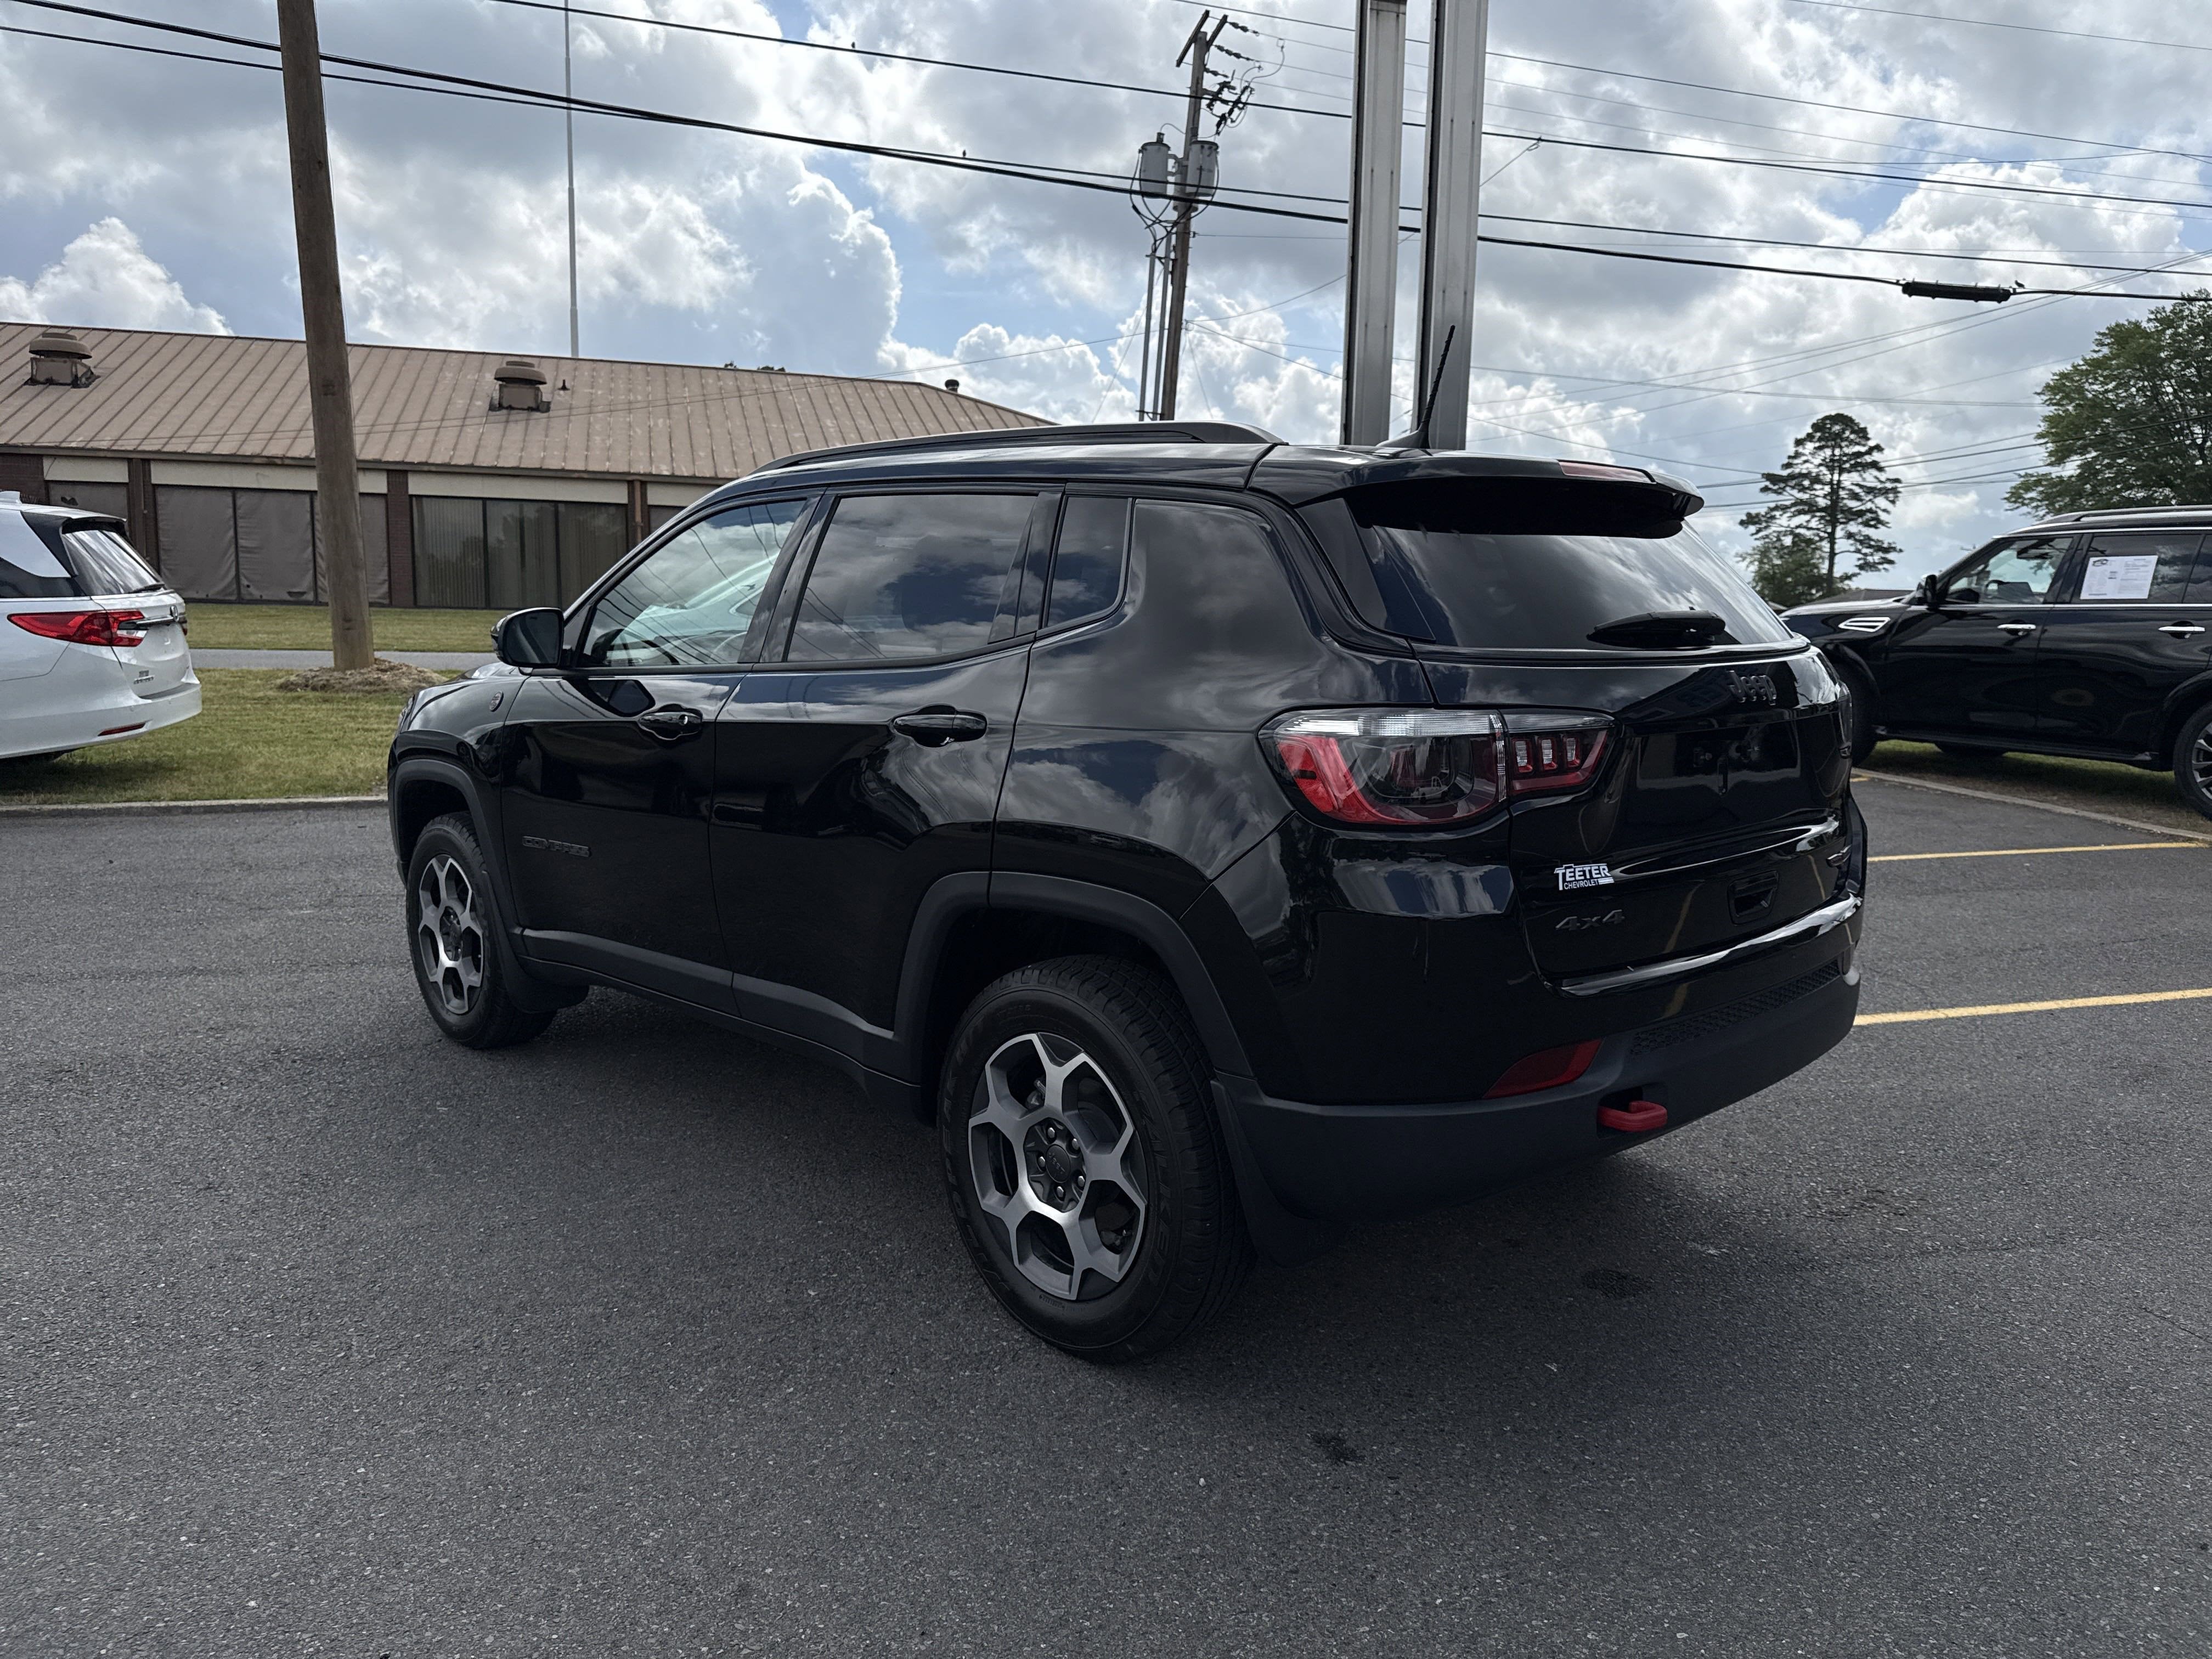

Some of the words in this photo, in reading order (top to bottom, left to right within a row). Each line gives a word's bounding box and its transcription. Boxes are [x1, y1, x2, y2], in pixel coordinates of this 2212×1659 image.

[1726, 670, 1778, 706] Jeep
[522, 835, 589, 857] COMPASS
[1555, 865, 1612, 891] TEETER
[1563, 878, 1599, 890] CHEVROLET
[1554, 909, 1626, 931] 4x4
